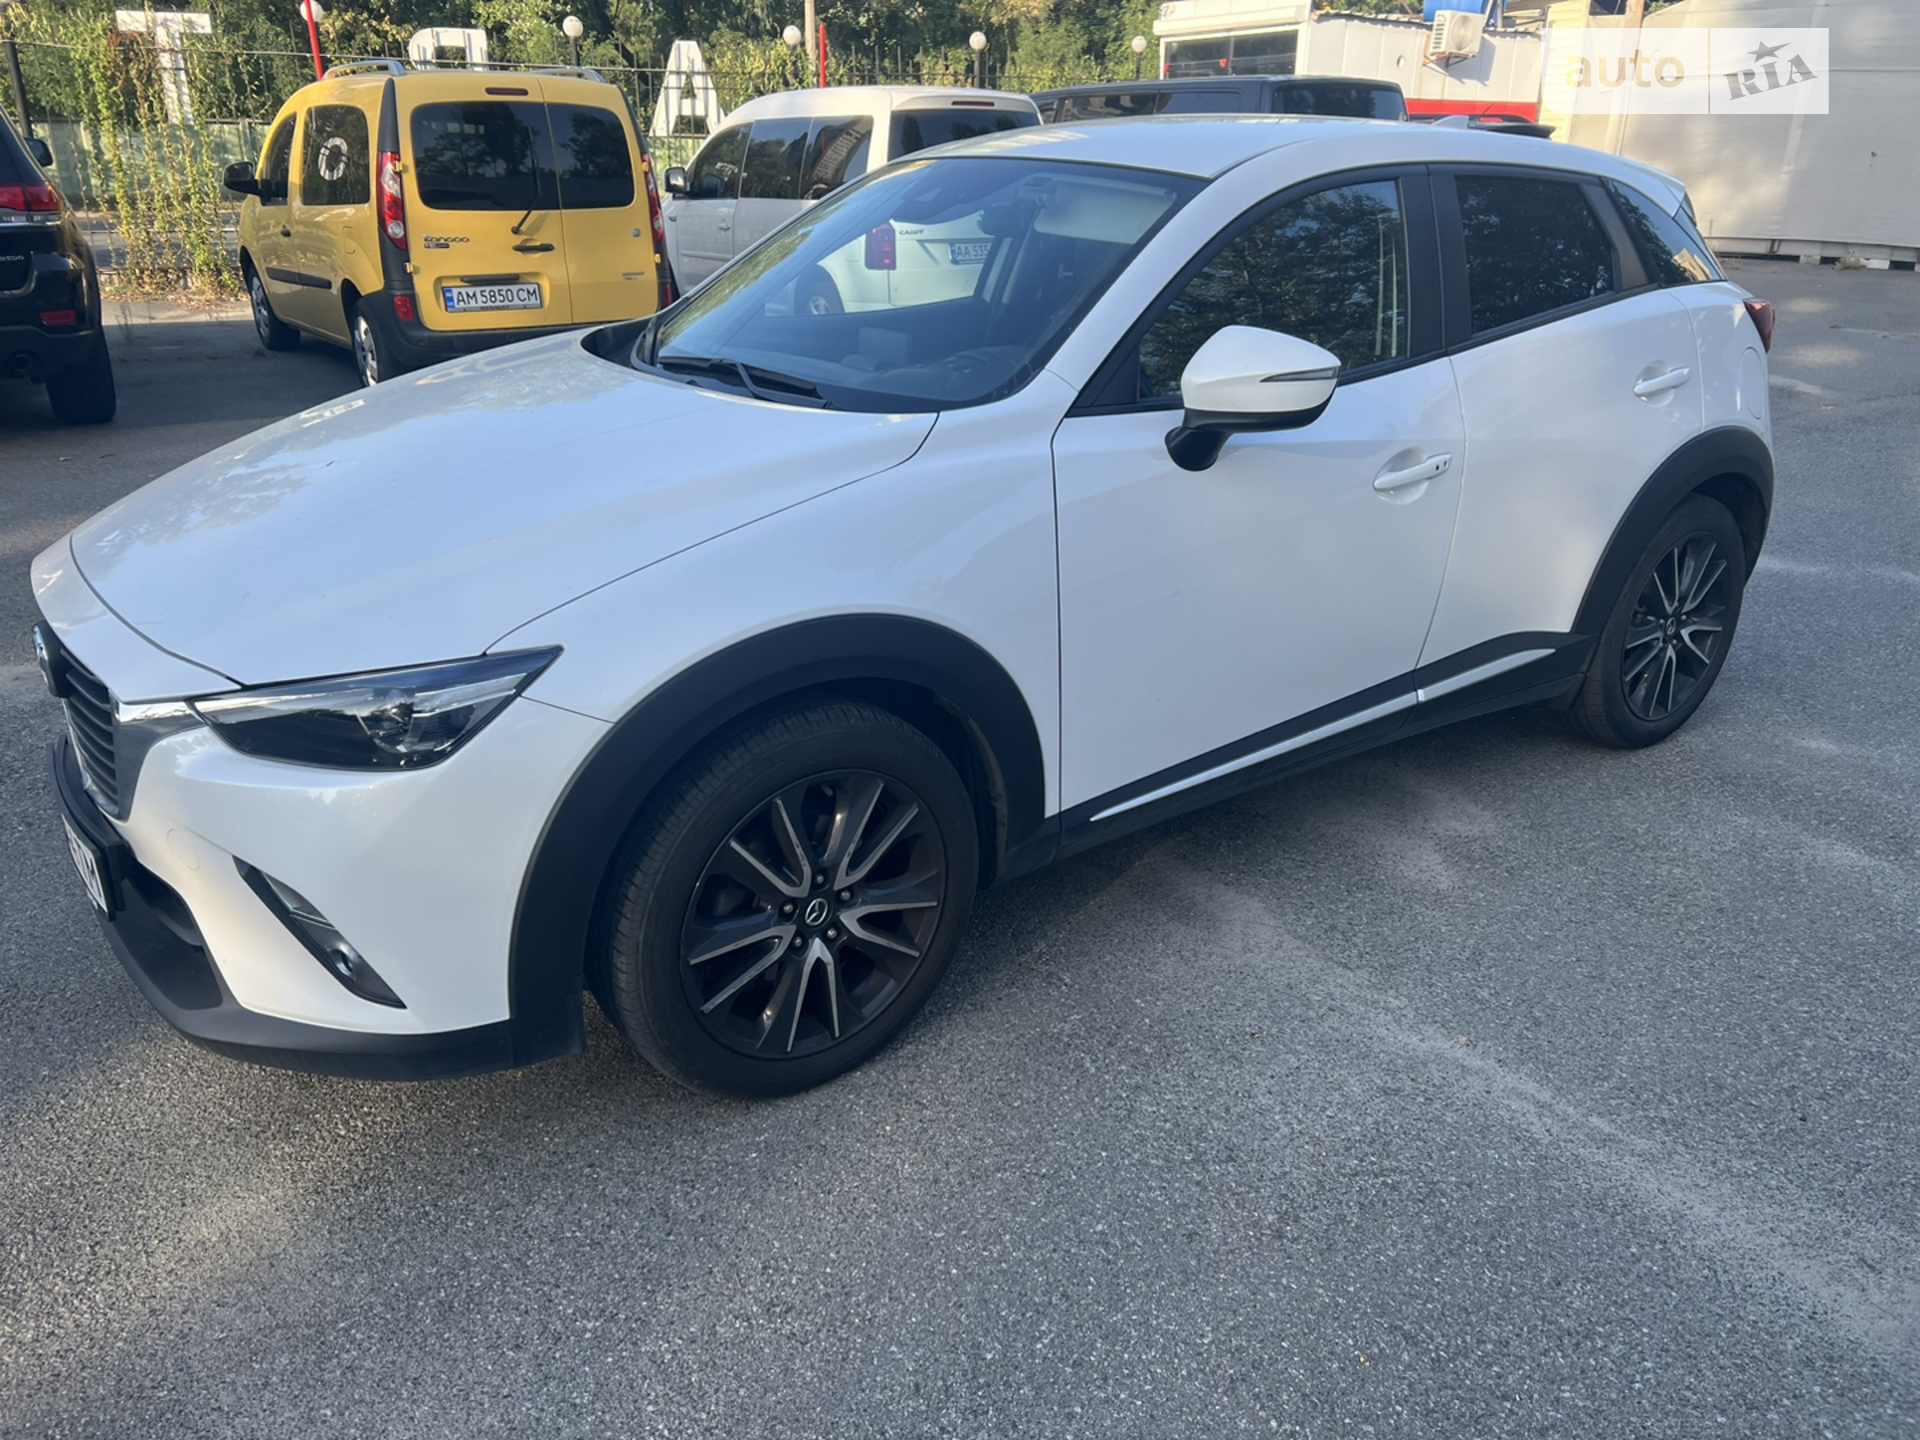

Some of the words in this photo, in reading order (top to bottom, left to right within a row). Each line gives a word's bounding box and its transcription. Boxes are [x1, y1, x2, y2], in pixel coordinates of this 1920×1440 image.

[456, 291, 478, 306] AM
[479, 288, 514, 304] 5850
[516, 287, 538, 302] CM
